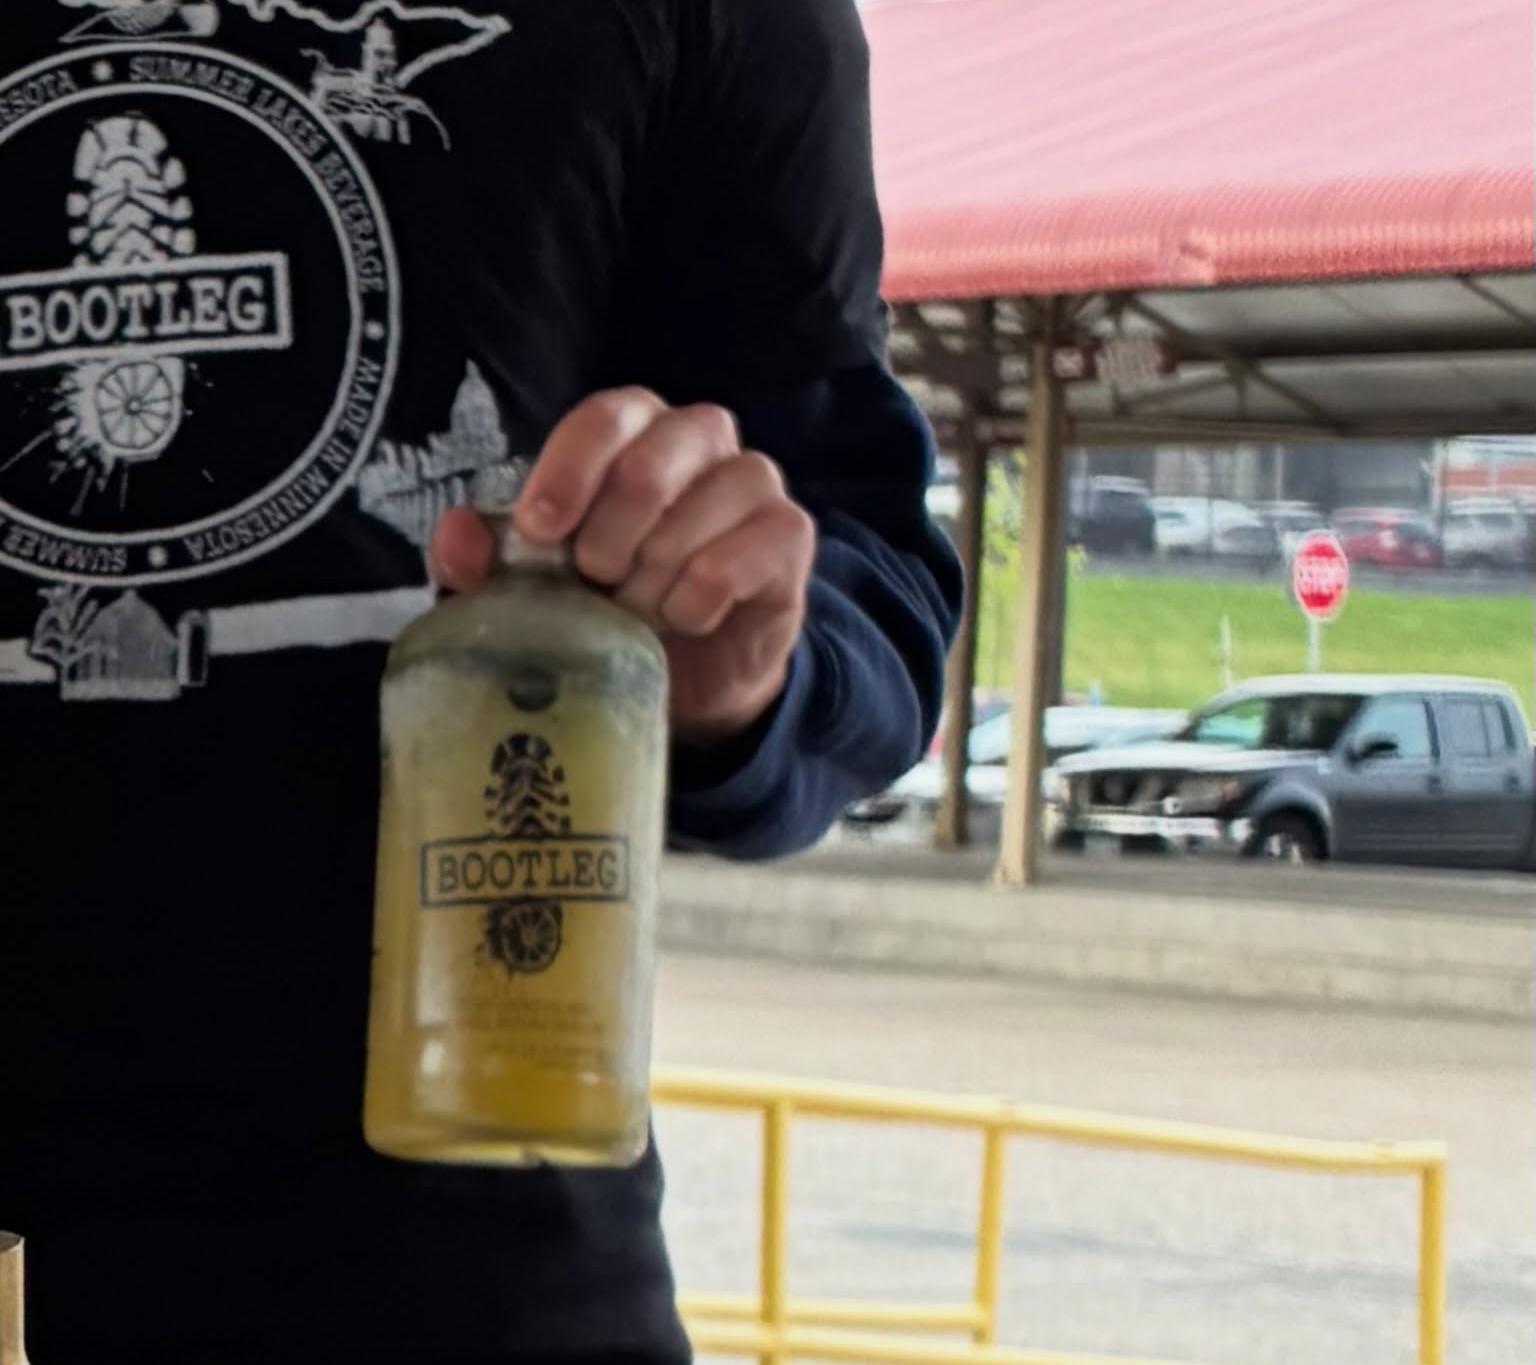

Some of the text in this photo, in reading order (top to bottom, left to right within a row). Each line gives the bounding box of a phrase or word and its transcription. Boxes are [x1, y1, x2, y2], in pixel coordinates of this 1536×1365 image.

[128, 55, 386, 294] SUMMER LAKES BEVERAGE
[5, 275, 267, 350] BOOTLEG
[183, 356, 382, 562] MADE IN MINNESOTA
[2, 524, 128, 573] SUMMER
[437, 848, 618, 895] BOOTLEG
